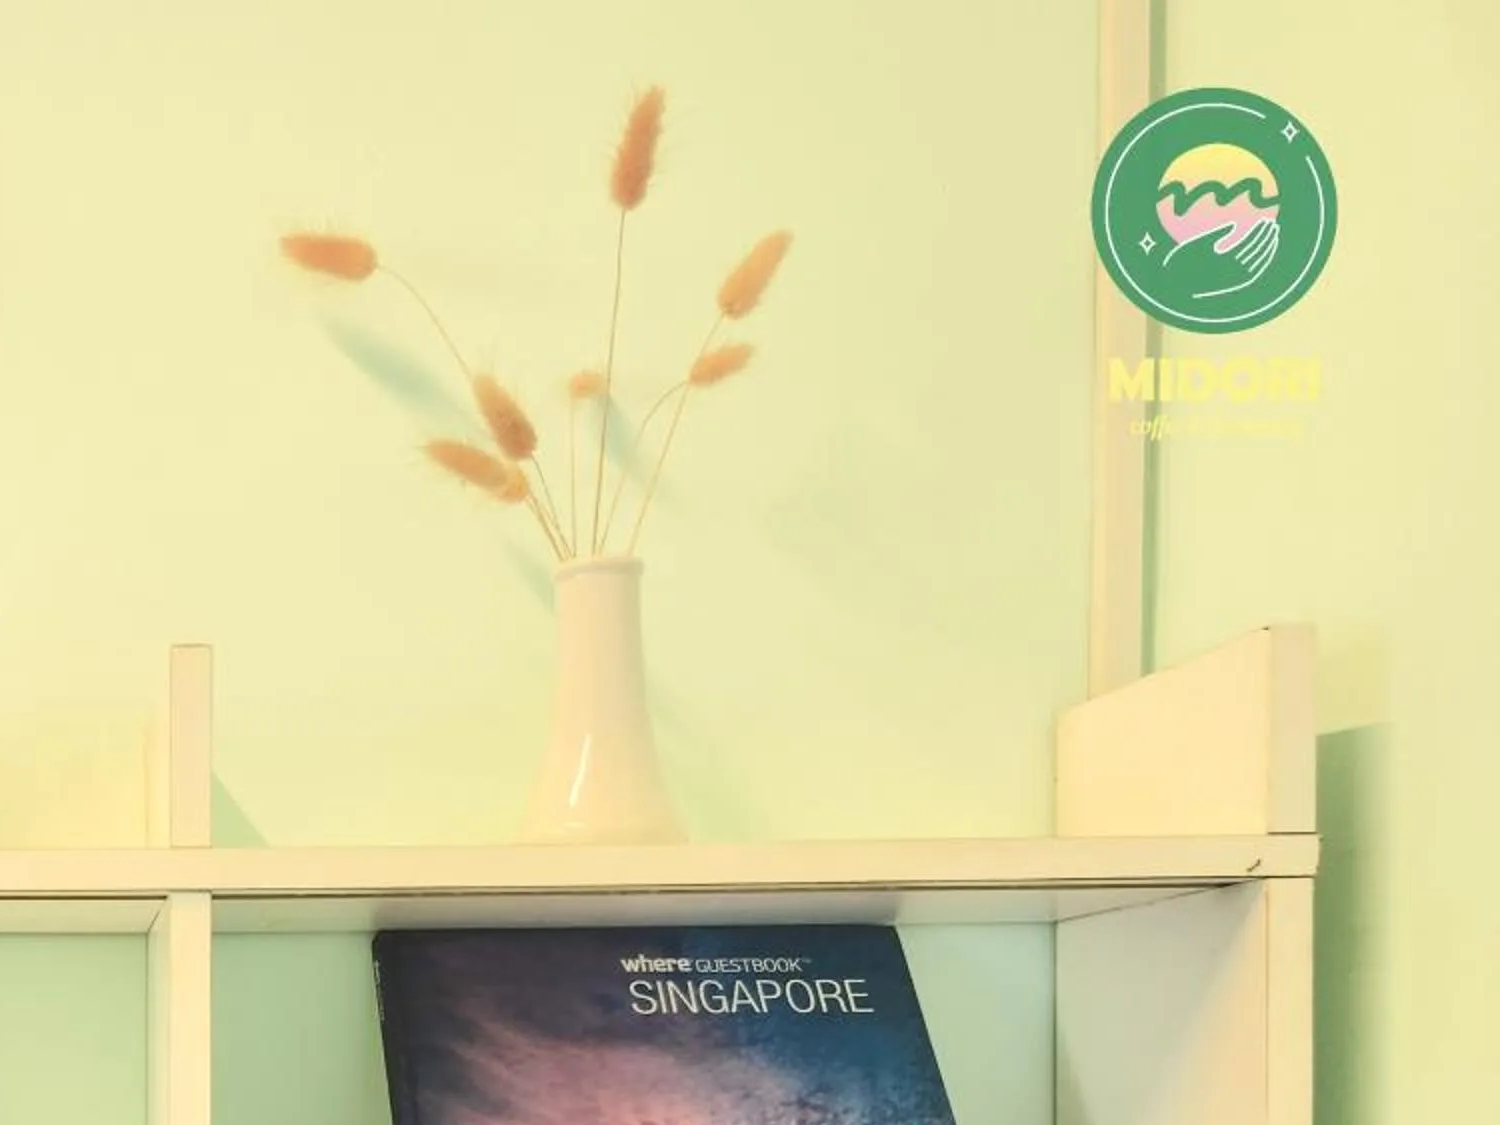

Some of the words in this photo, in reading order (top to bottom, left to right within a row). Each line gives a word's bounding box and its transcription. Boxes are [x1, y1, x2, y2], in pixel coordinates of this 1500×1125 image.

[620, 954, 693, 973] where
[695, 958, 802, 974] GUESTBOOK
[629, 979, 875, 1015] SINGAPORE
